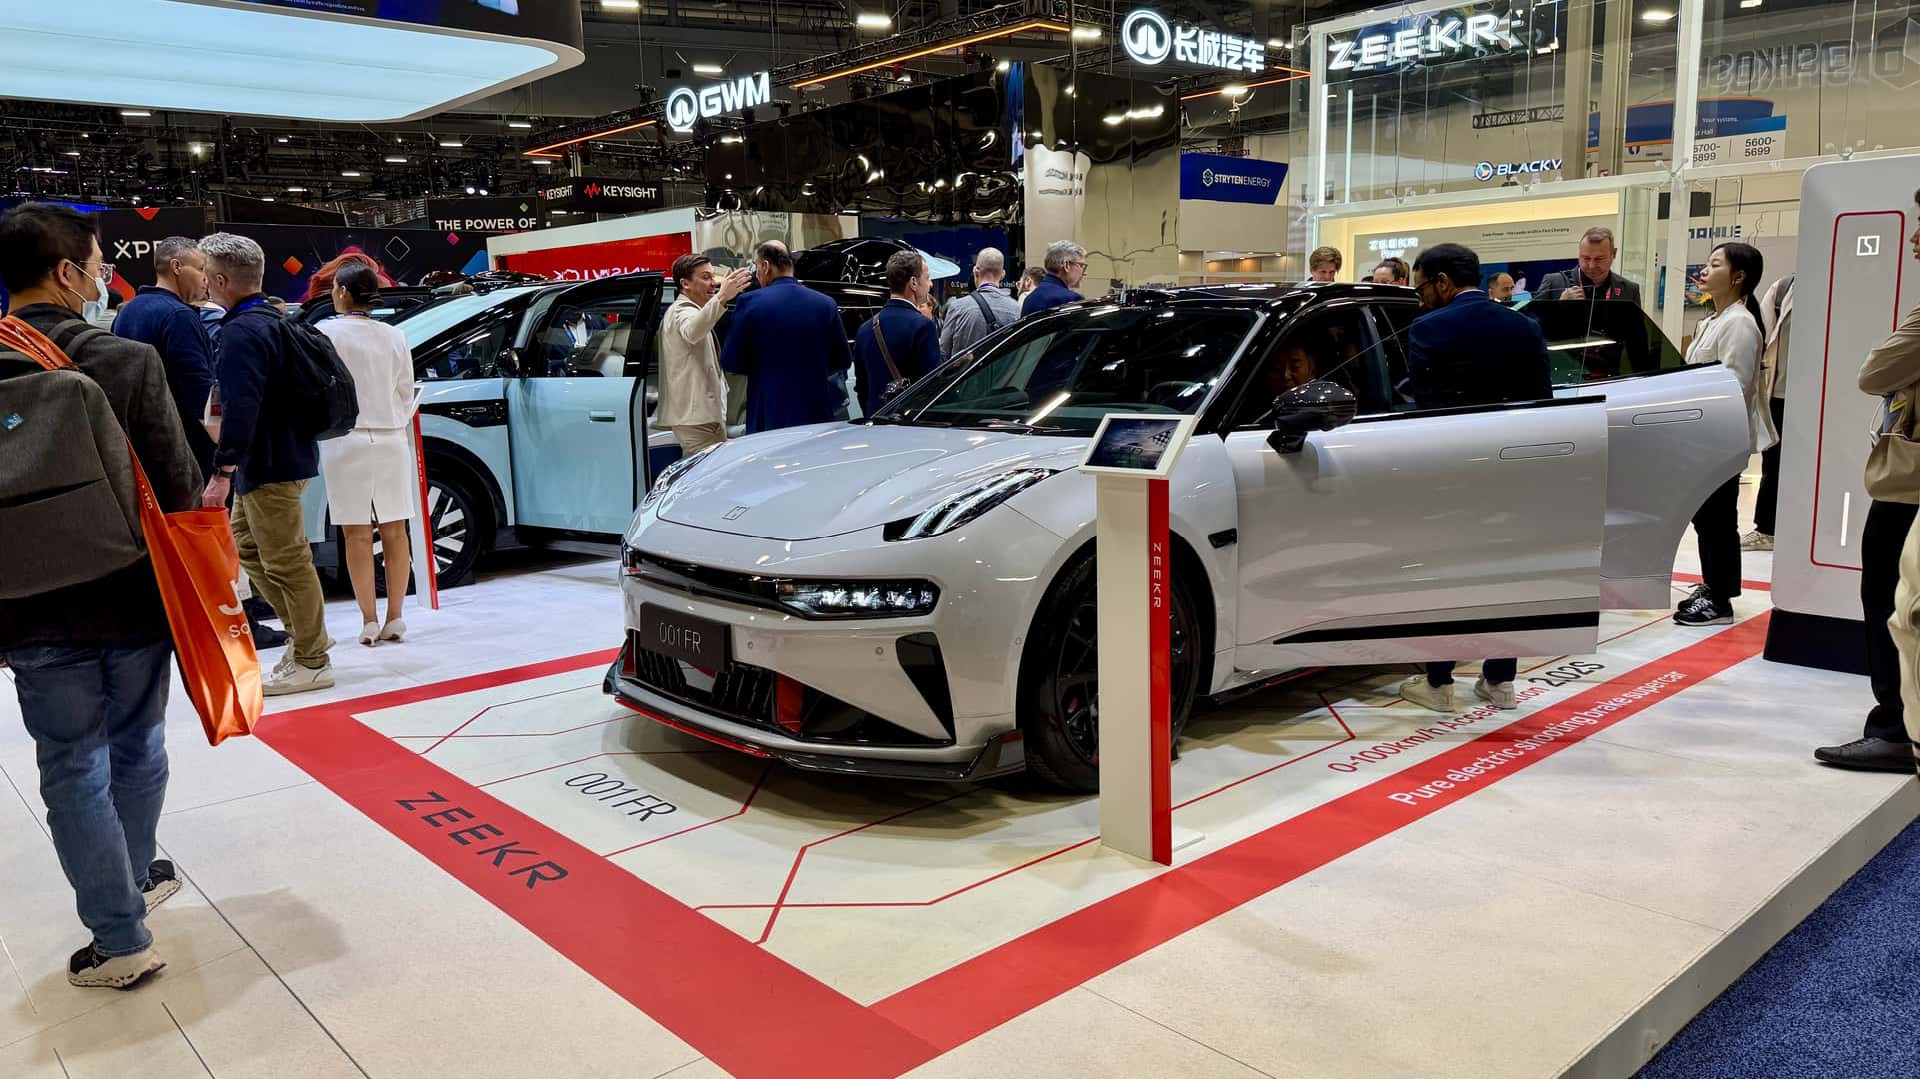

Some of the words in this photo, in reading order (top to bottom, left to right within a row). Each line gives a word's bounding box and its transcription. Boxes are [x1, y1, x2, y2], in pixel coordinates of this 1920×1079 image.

[1174, 26, 1265, 73] 长城汽车
[1328, 14, 1504, 71] ZEEKR
[699, 71, 771, 118] GWM
[1744, 147, 1771, 157] 5699
[1745, 137, 1777, 148] 5600-
[546, 184, 573, 201] KEYSIGHT
[602, 185, 657, 199] KEYSIGHT
[435, 219, 462, 231] THE
[465, 217, 515, 231] POWER
[518, 217, 537, 229] OF
[1153, 542, 1162, 608] ZEEKR
[659, 622, 681, 647] 001
[684, 629, 702, 655] FR
[1327, 728, 1445, 773] 0-100km/h
[1387, 779, 1455, 806] Pure
[1446, 747, 1525, 782] electric
[1513, 716, 1598, 751] shooting
[1573, 692, 1633, 719] brake
[1626, 670, 1688, 700] supercar
[564, 772, 639, 801] 001
[611, 794, 677, 822] FR
[394, 790, 570, 890] ZEEKR
